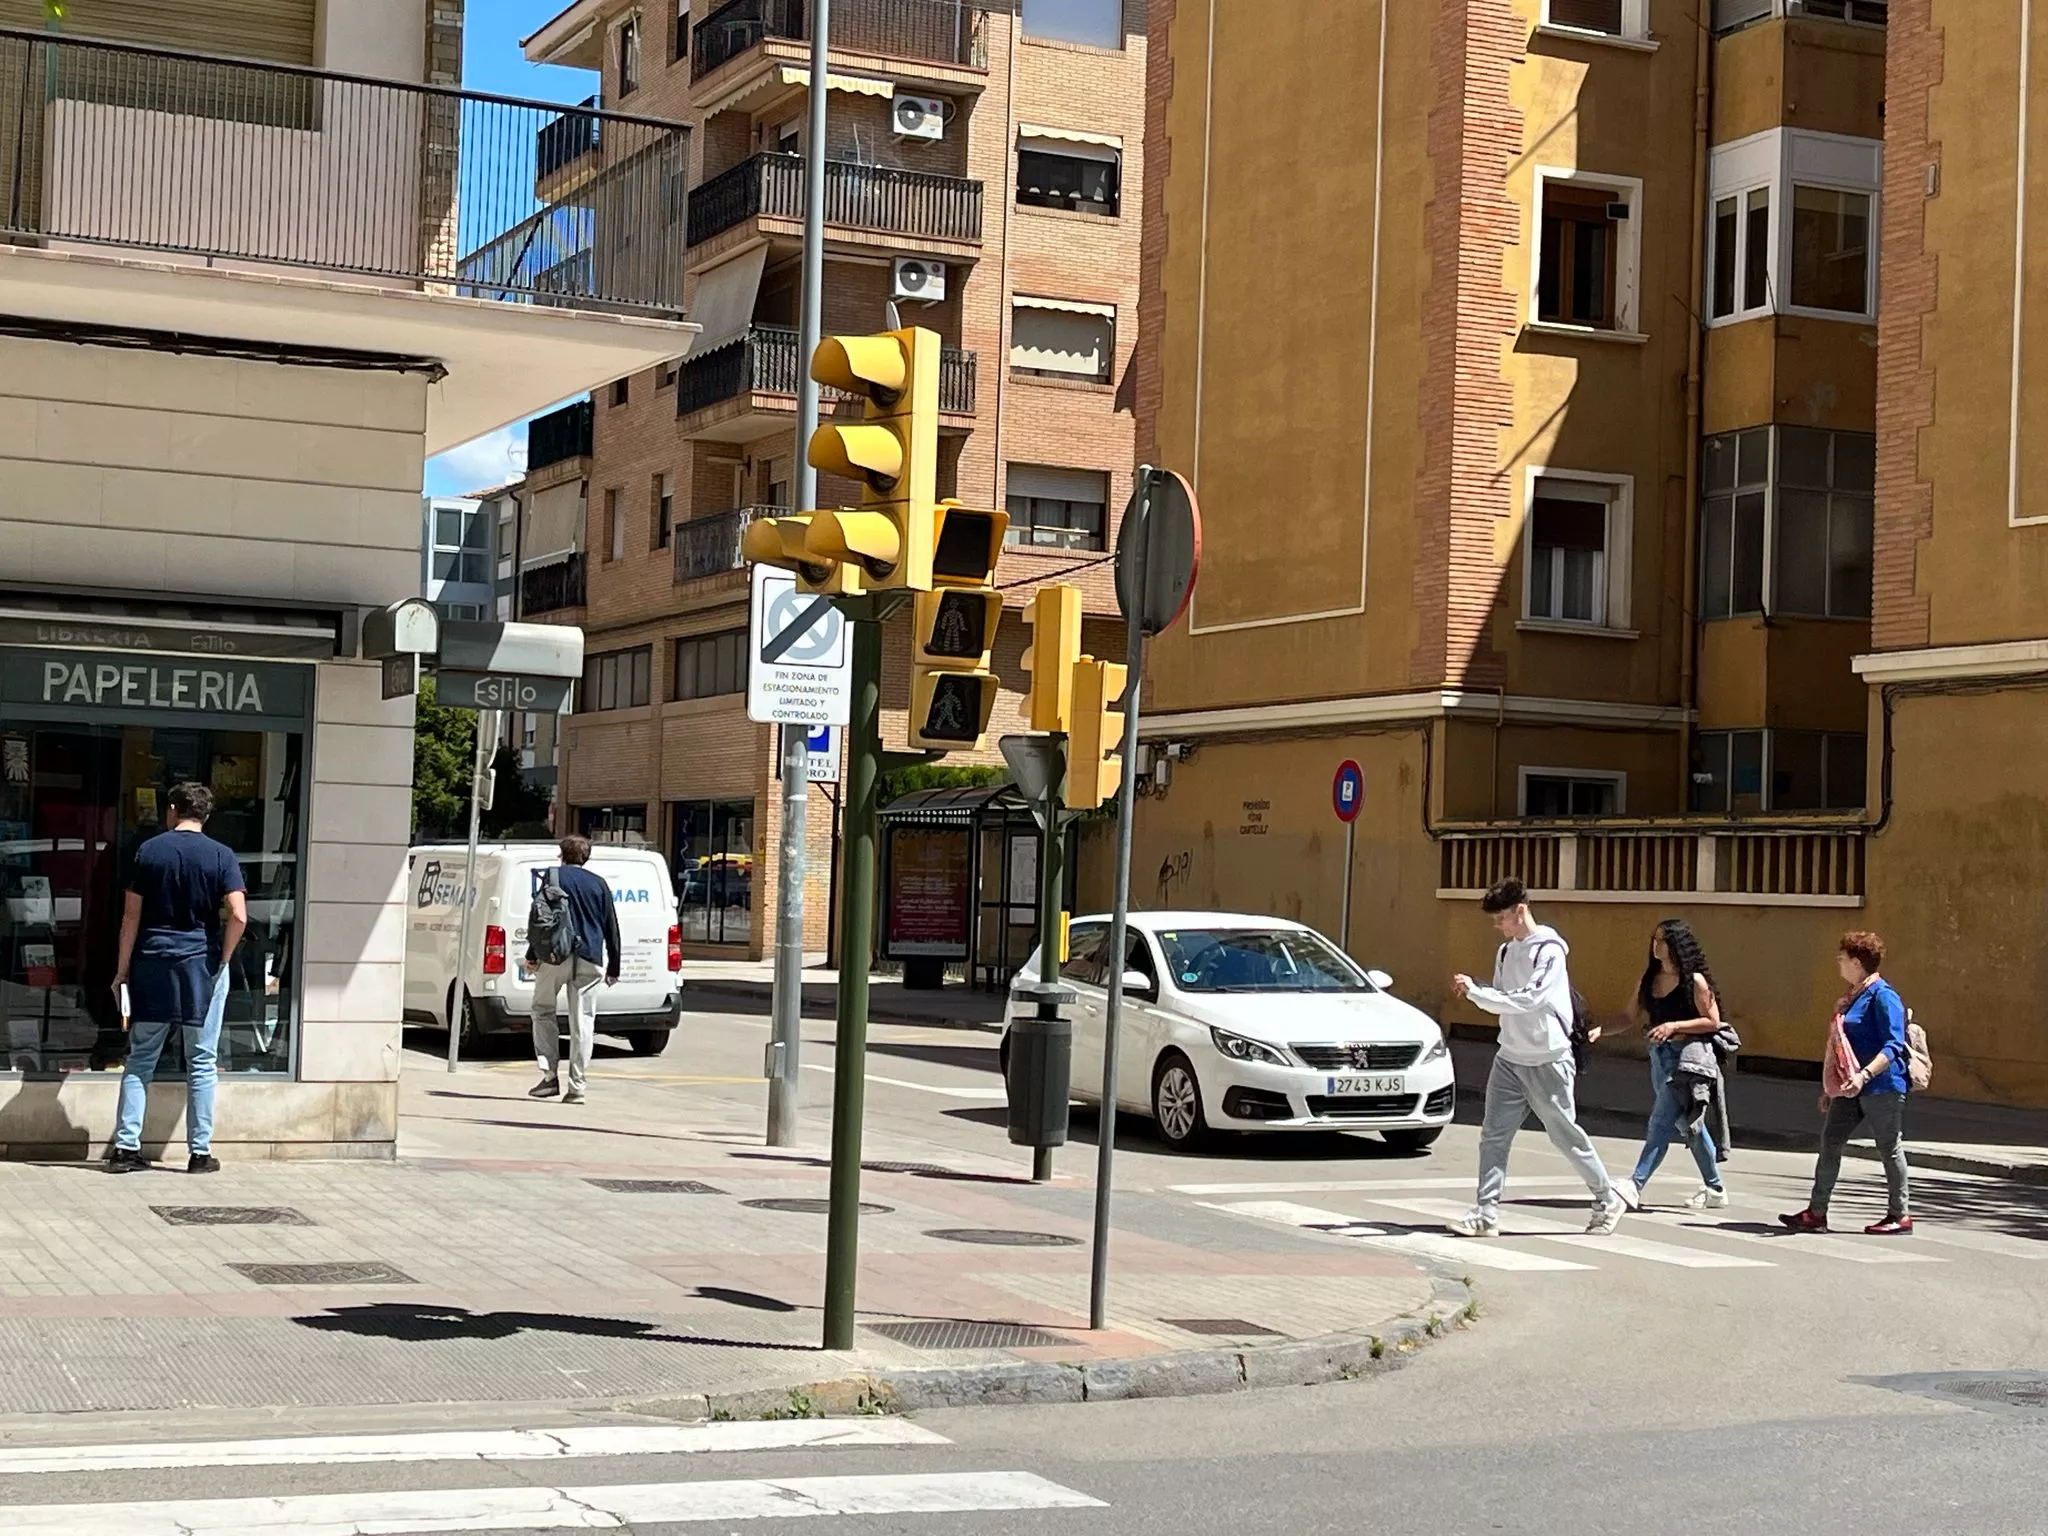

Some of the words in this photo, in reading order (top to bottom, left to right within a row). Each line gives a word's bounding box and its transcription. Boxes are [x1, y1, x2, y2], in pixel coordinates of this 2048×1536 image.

[775, 671, 789, 679] FIN
[791, 672, 815, 681] ZONA
[818, 673, 828, 681] DE
[43, 661, 263, 712] PAPELERIA
[763, 683, 839, 695] ESTACIONAMIENTO
[779, 697, 817, 707] LIMITADO
[772, 710, 828, 720] CONTROLADO
[809, 758, 833, 768] TEL
[611, 889, 649, 902] MAR
[1336, 1079, 1370, 1093] 2743
[1375, 1078, 1400, 1092] KJS
